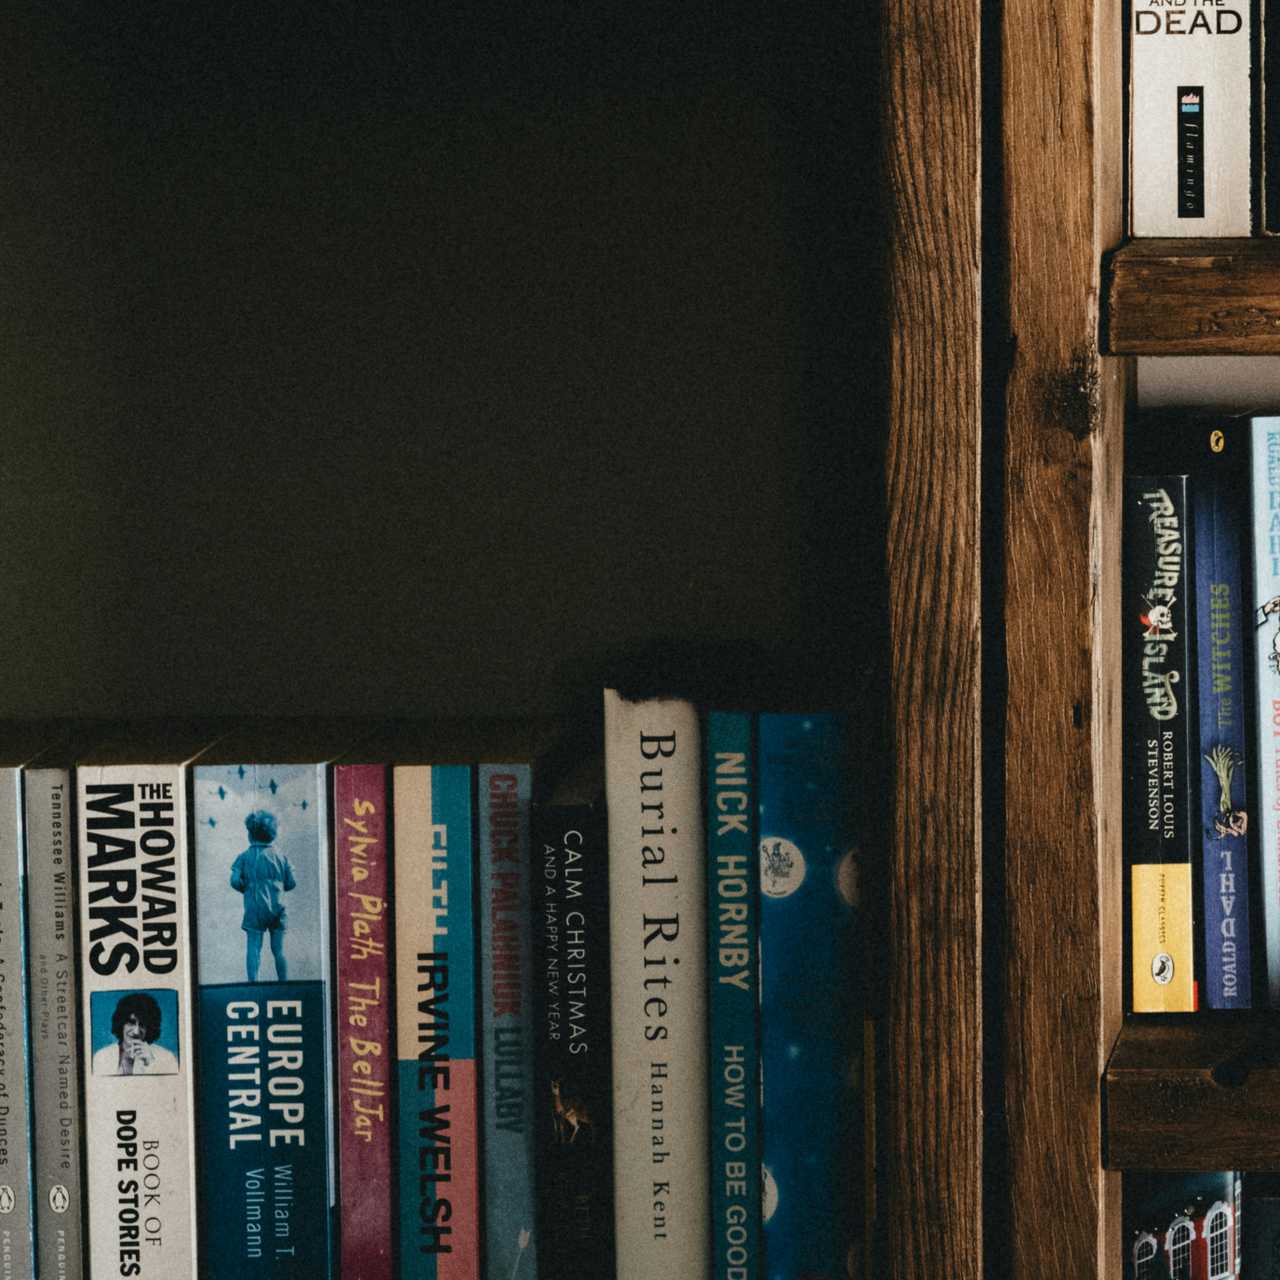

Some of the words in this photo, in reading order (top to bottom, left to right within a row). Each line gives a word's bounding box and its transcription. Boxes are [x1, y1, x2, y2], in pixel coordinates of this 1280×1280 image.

[1148, 740, 1160, 830] STEVENSON
[1163, 731, 1174, 789] ROBERT
[344, 800, 381, 884] Sylvia
[638, 731, 677, 887] Burial
[1163, 795, 1175, 839] LOUIS
[563, 830, 584, 899] CALM
[349, 893, 387, 959] Plath
[348, 978, 379, 1026] The
[566, 911, 587, 1055] CHRISTMAS
[642, 913, 679, 1041] Rites
[416, 952, 448, 1090] IRVINE
[226, 1000, 262, 1150] CENTRAL
[267, 1000, 304, 1147] EUROPE
[350, 1038, 383, 1093] Bell
[351, 1099, 384, 1142] Jar
[650, 1062, 670, 1164] Hannah
[244, 1168, 264, 1258] Vollmann
[274, 1164, 294, 1239] William
[420, 1105, 451, 1254] WELSH
[652, 1182, 670, 1240] Kent
[274, 1245, 294, 1260] T.
